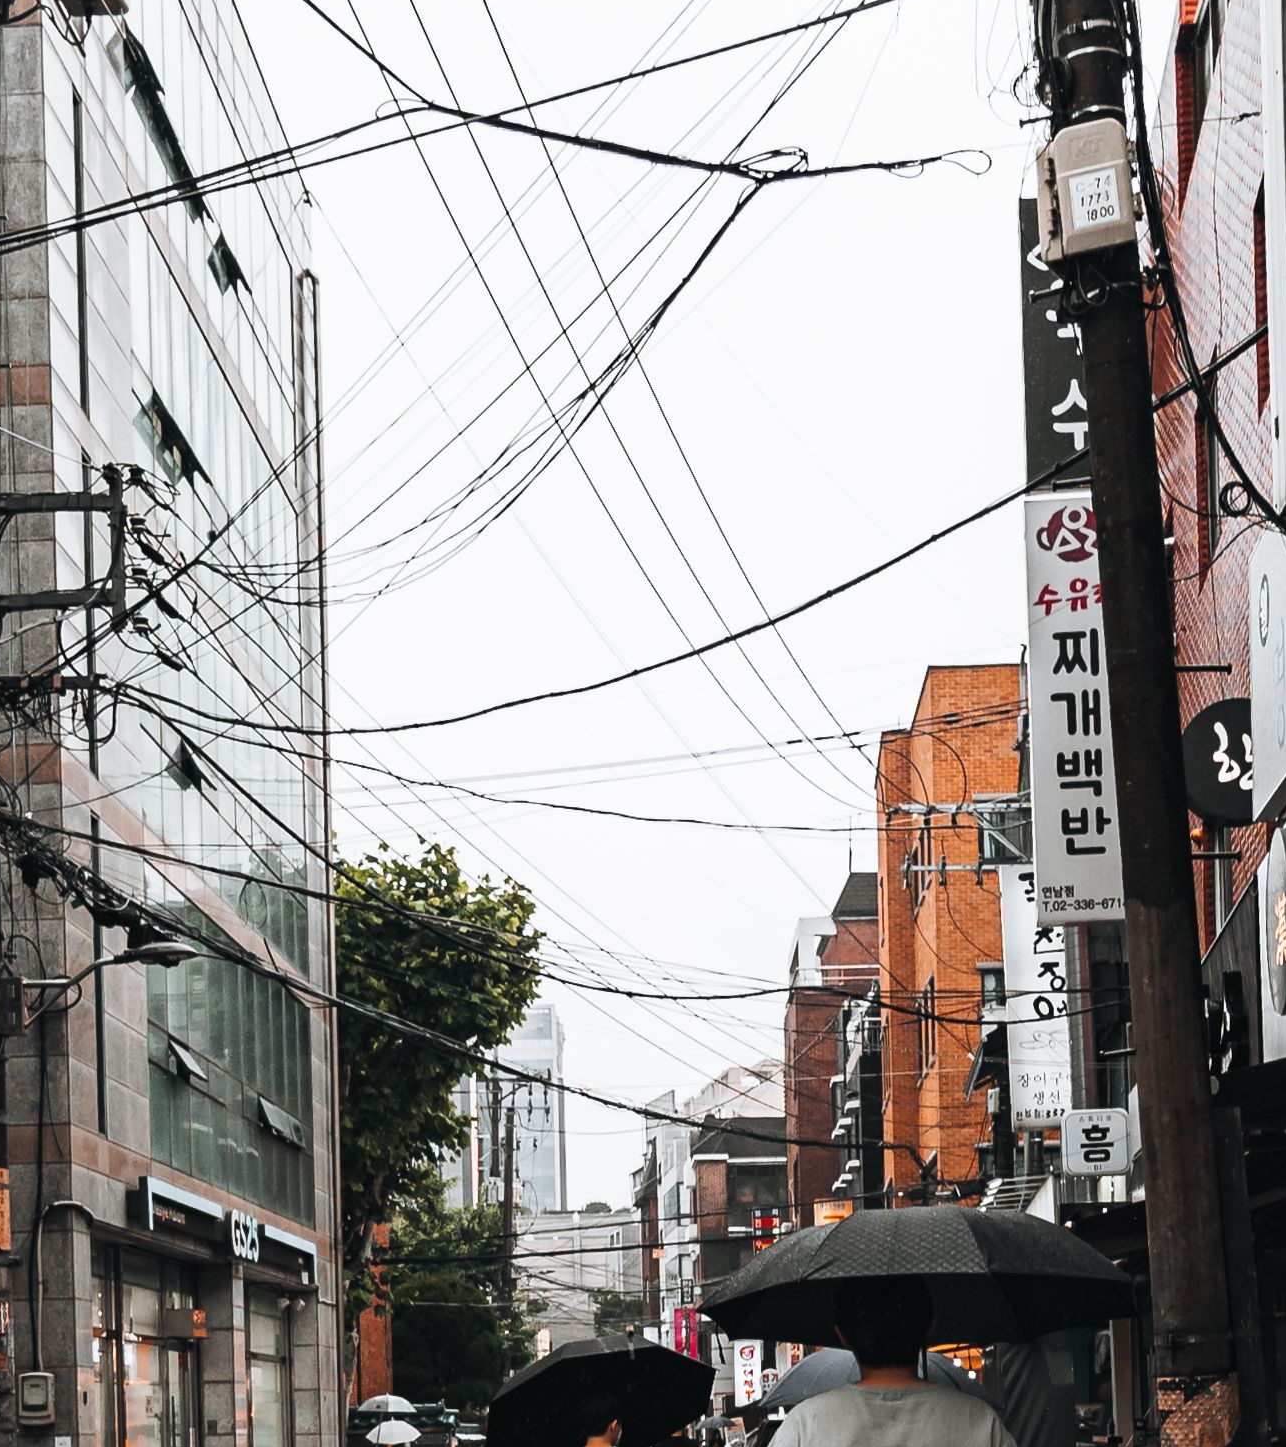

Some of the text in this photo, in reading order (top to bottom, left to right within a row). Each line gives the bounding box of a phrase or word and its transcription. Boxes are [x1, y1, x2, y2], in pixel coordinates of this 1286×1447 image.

[1086, 204, 1115, 222] 1800
[1032, 577, 1104, 617] 수유
[1050, 626, 1113, 857] 찌개백반
[1041, 884, 1075, 899] 연남점
[1080, 1124, 1115, 1164] 흥
[231, 1208, 260, 1263] GS25
